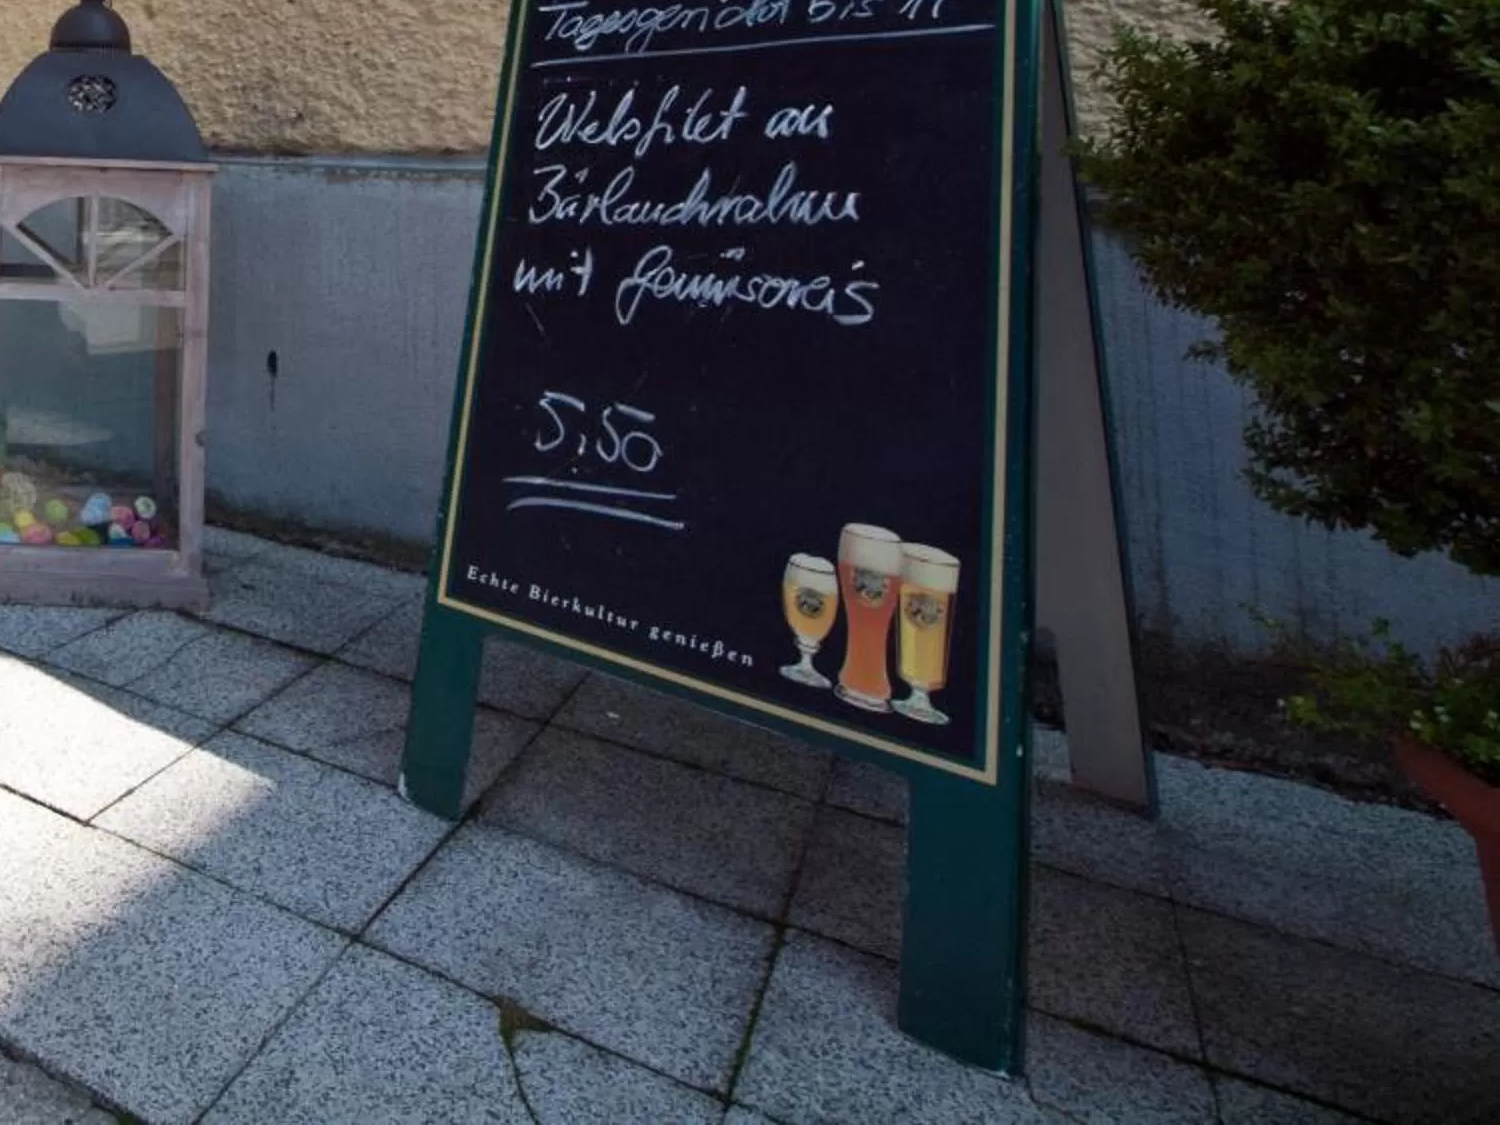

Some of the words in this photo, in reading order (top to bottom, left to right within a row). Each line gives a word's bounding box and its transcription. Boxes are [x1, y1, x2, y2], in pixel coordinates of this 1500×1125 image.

[512, 246, 595, 297] mit
[467, 564, 520, 594] Echte
[528, 583, 639, 631] Bierkultur
[649, 625, 754, 668] genießen
